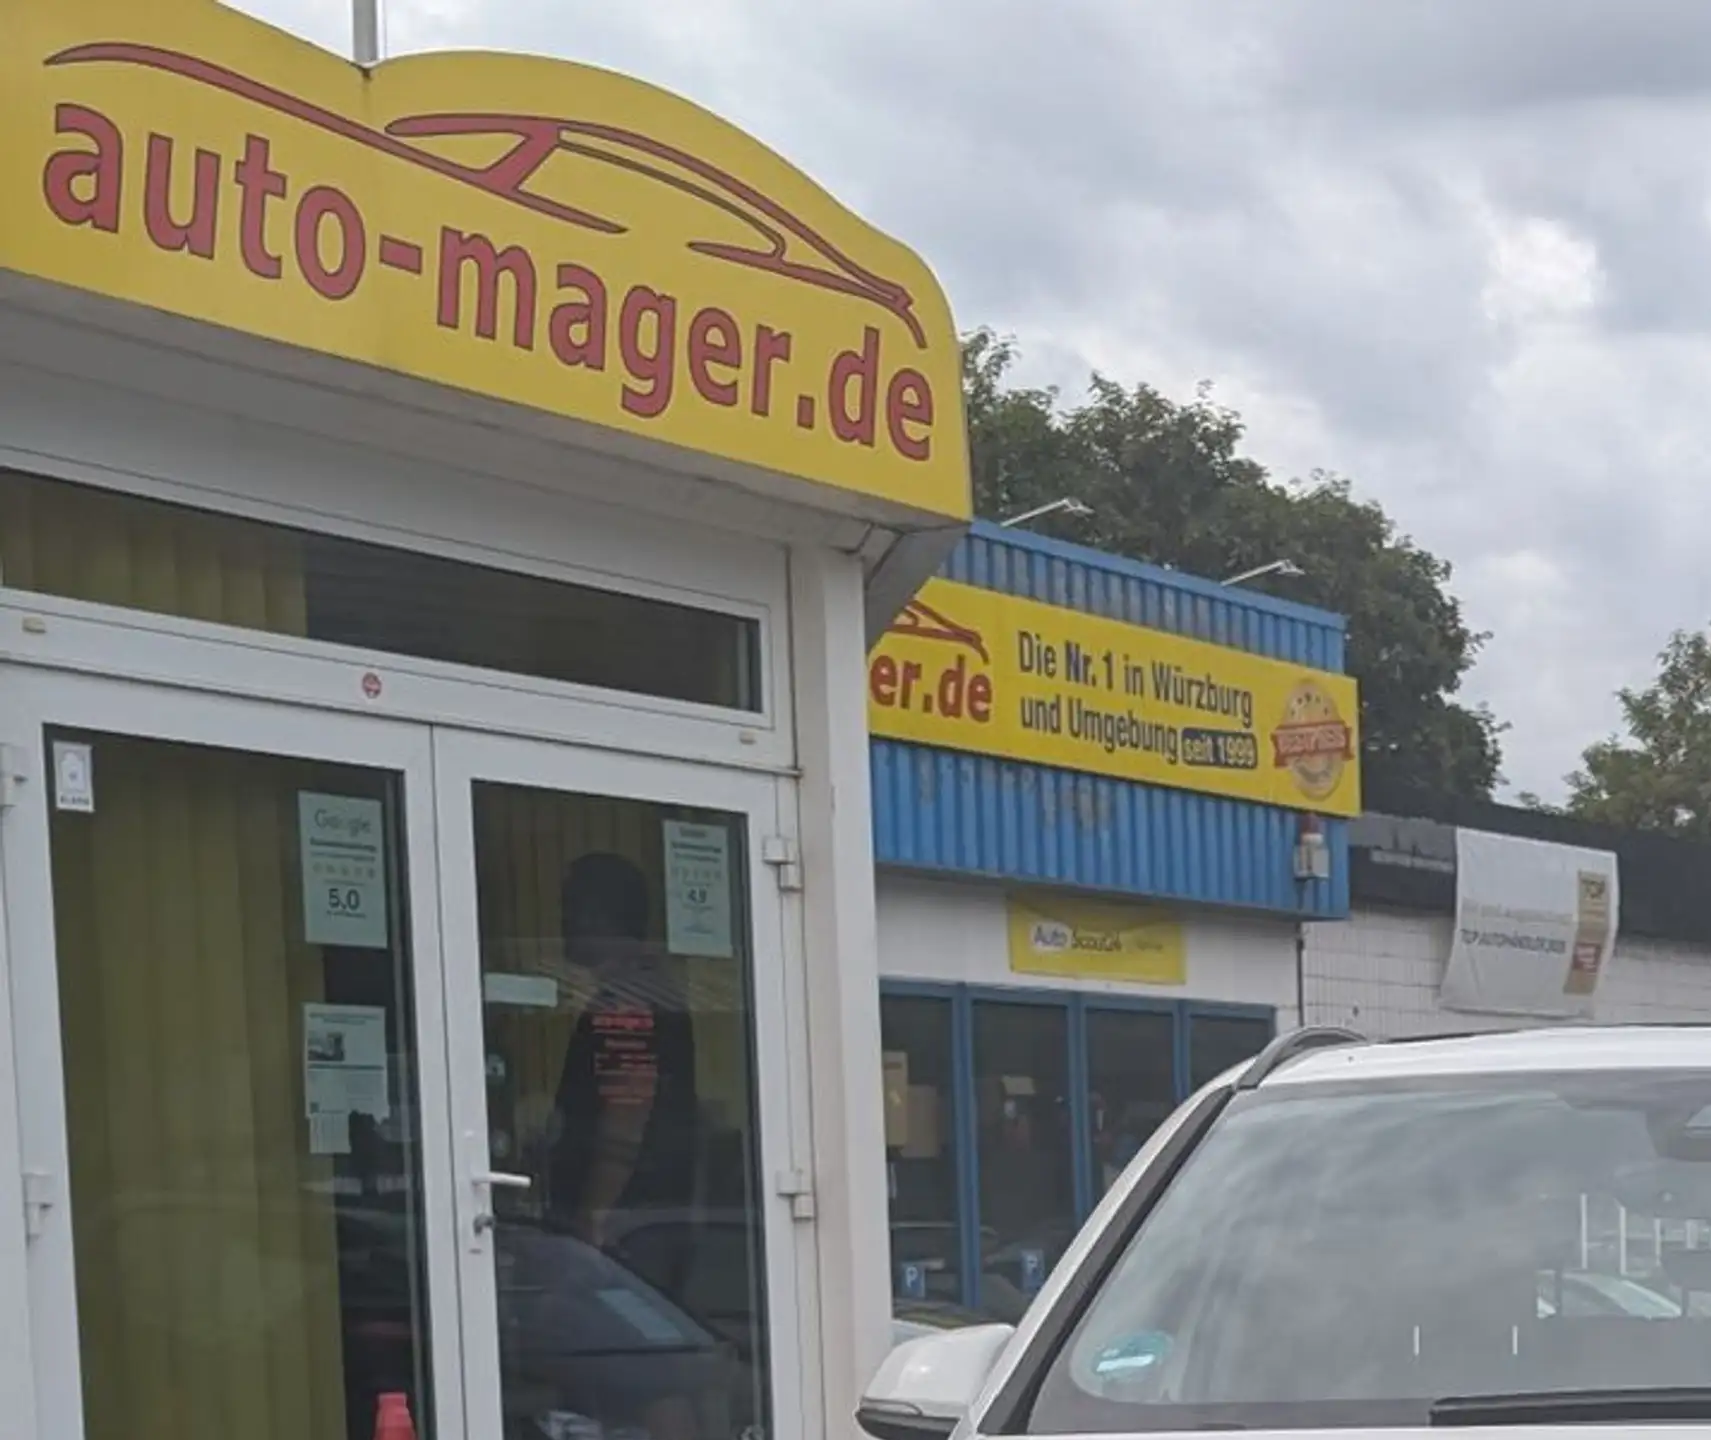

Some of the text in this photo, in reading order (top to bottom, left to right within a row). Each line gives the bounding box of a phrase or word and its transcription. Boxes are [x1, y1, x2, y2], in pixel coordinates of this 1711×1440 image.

[42, 102, 935, 461] auto-mager.de
[1017, 630, 1253, 728] Die Nr. 1 in Würzburg
[1020, 694, 1256, 767] und Umgebung seit 1999
